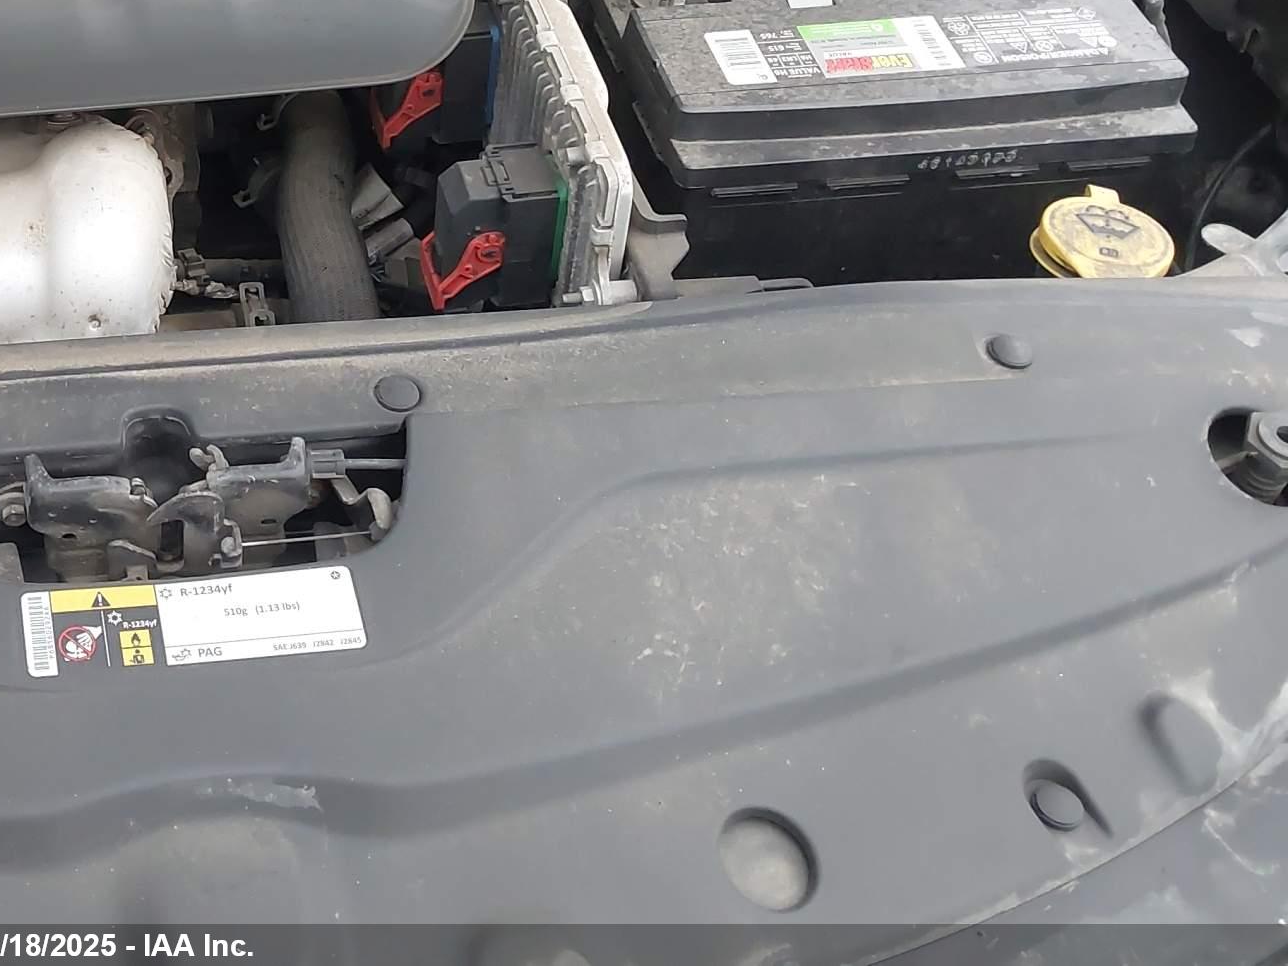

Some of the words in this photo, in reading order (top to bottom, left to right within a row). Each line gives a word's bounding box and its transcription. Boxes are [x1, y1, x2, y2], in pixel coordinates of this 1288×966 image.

[180, 582, 233, 598] R-1234yf
[223, 607, 249, 618] 510g
[282, 600, 301, 611] lbs)
[198, 645, 223, 659] PAG
